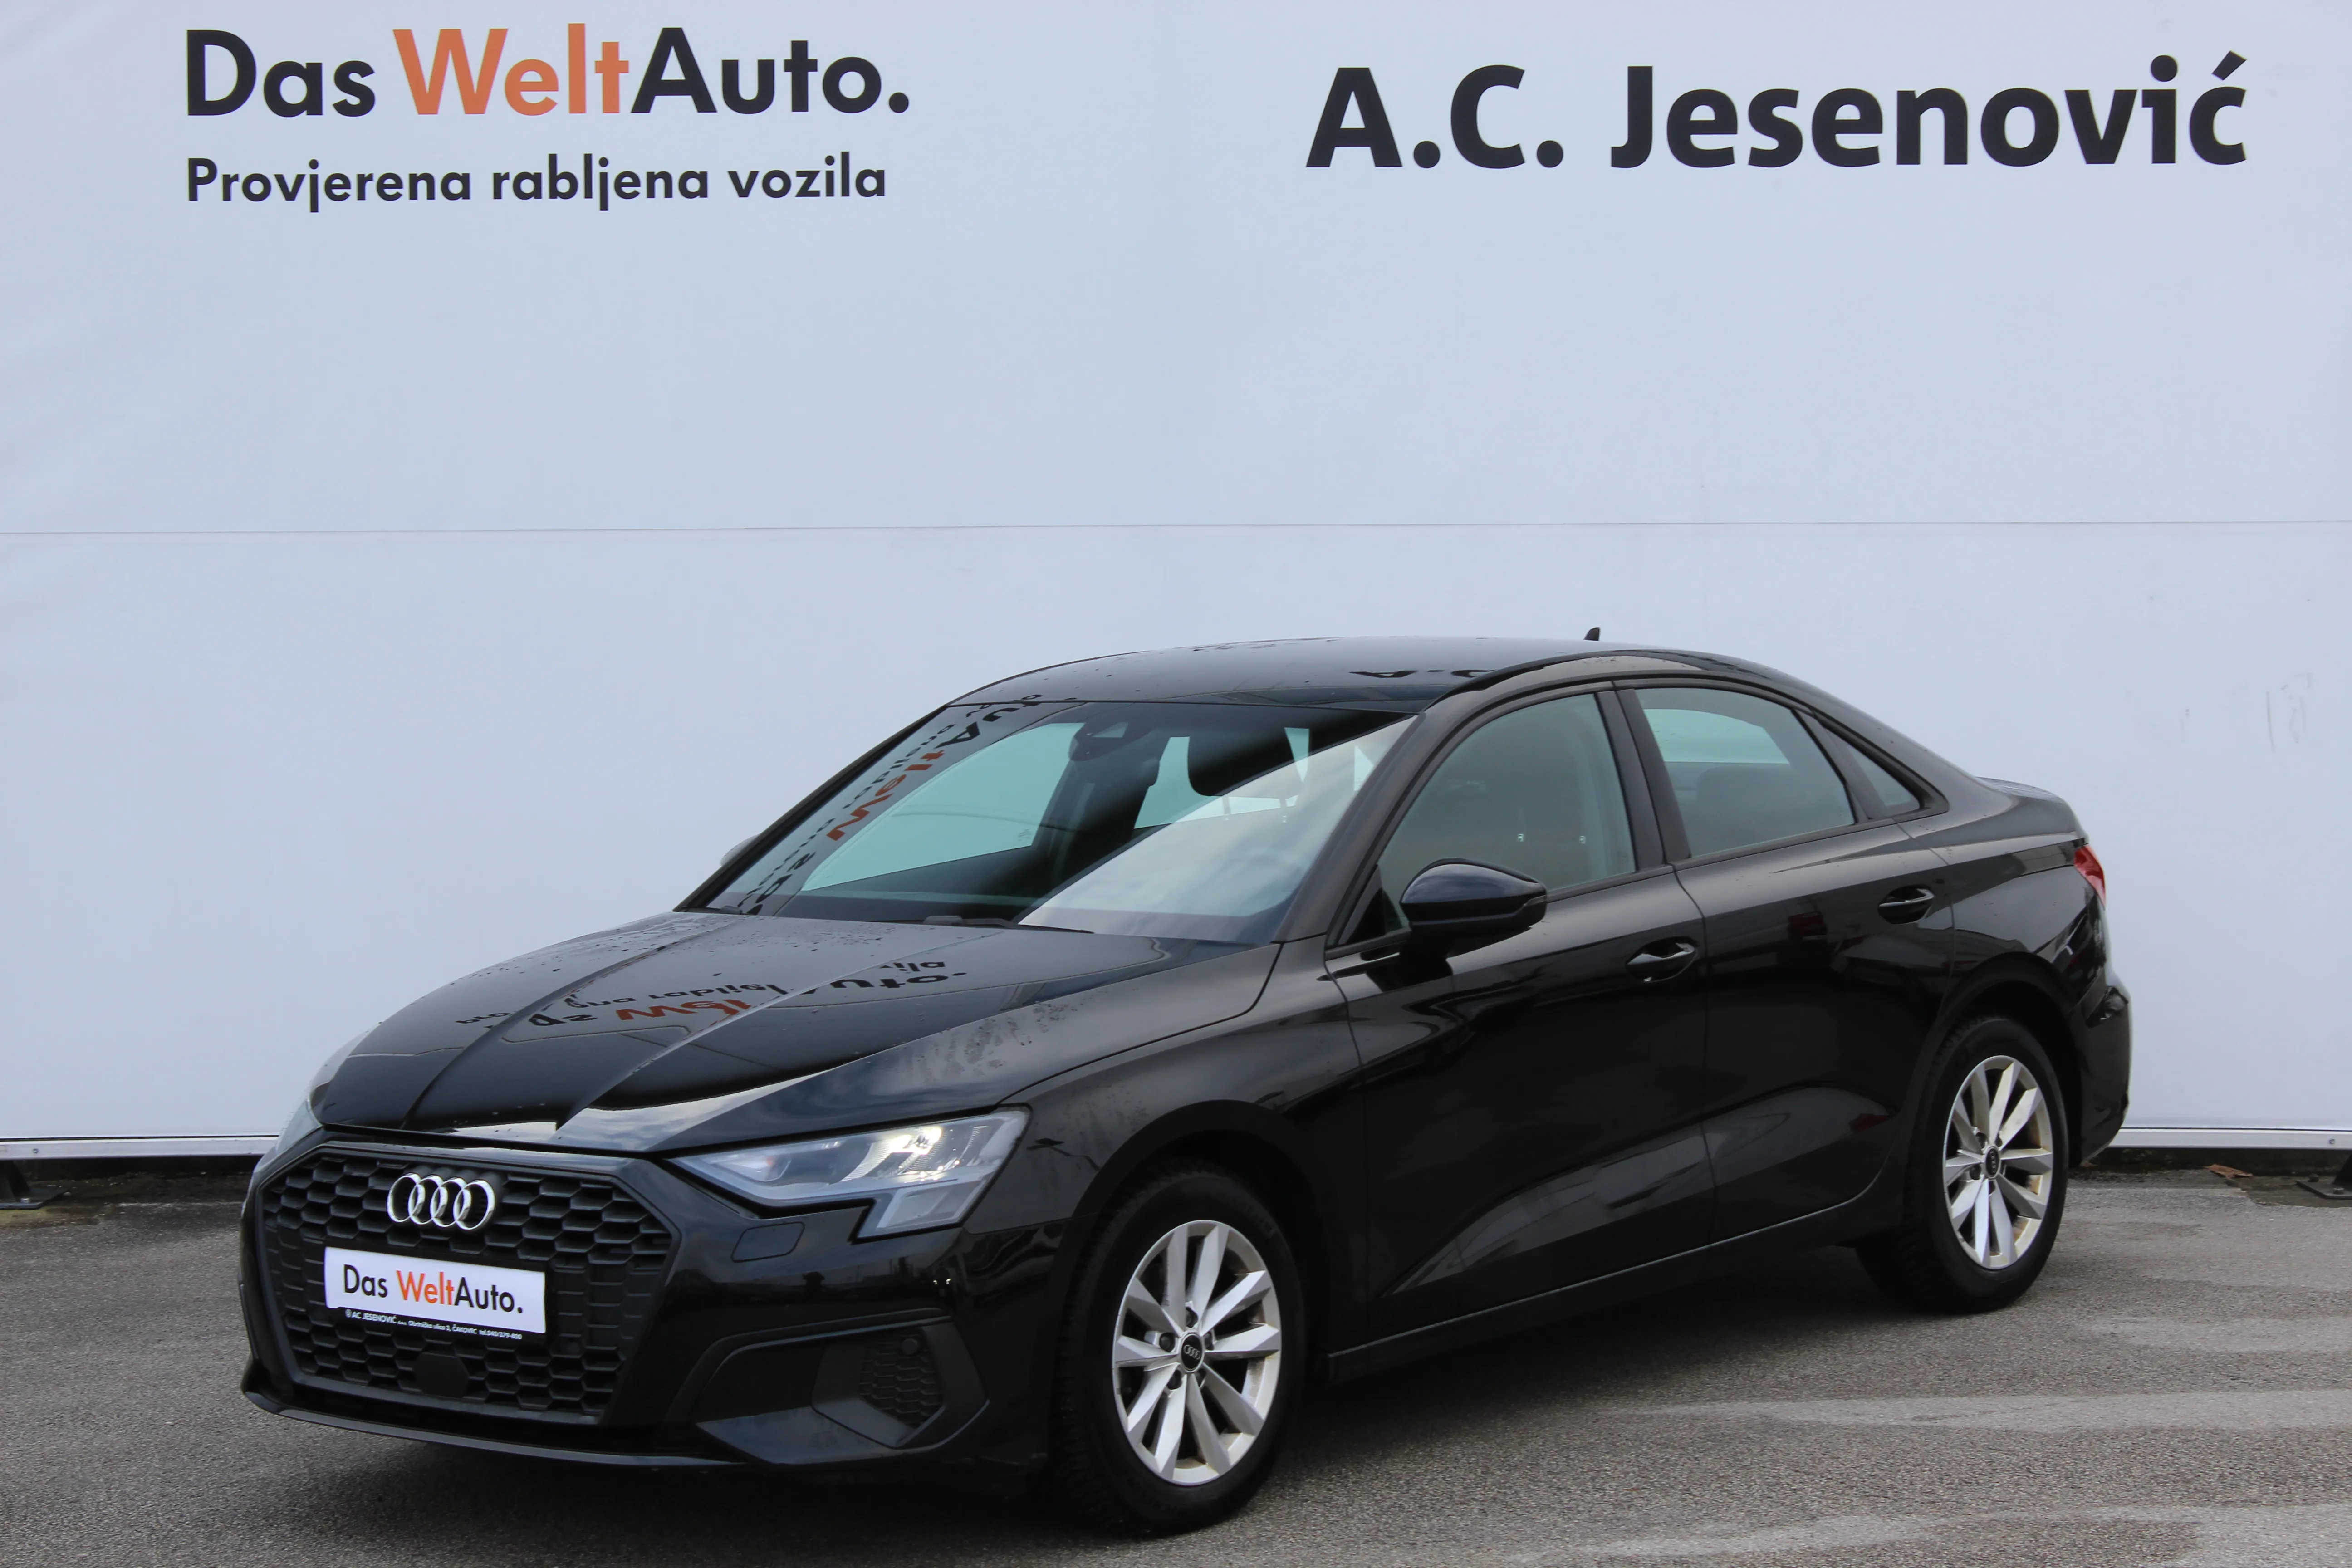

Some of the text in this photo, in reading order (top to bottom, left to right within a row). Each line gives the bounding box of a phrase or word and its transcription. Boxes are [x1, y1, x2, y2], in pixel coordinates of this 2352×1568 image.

[186, 23, 909, 118] Das WeltAuto.
[1306, 50, 2247, 169] A.C. Jesenović
[188, 151, 885, 213] Provjerena rabljena vozila
[343, 1264, 523, 1314] Das WeltAuto.
[362, 1313, 397, 1324] JESENOVIĆ
